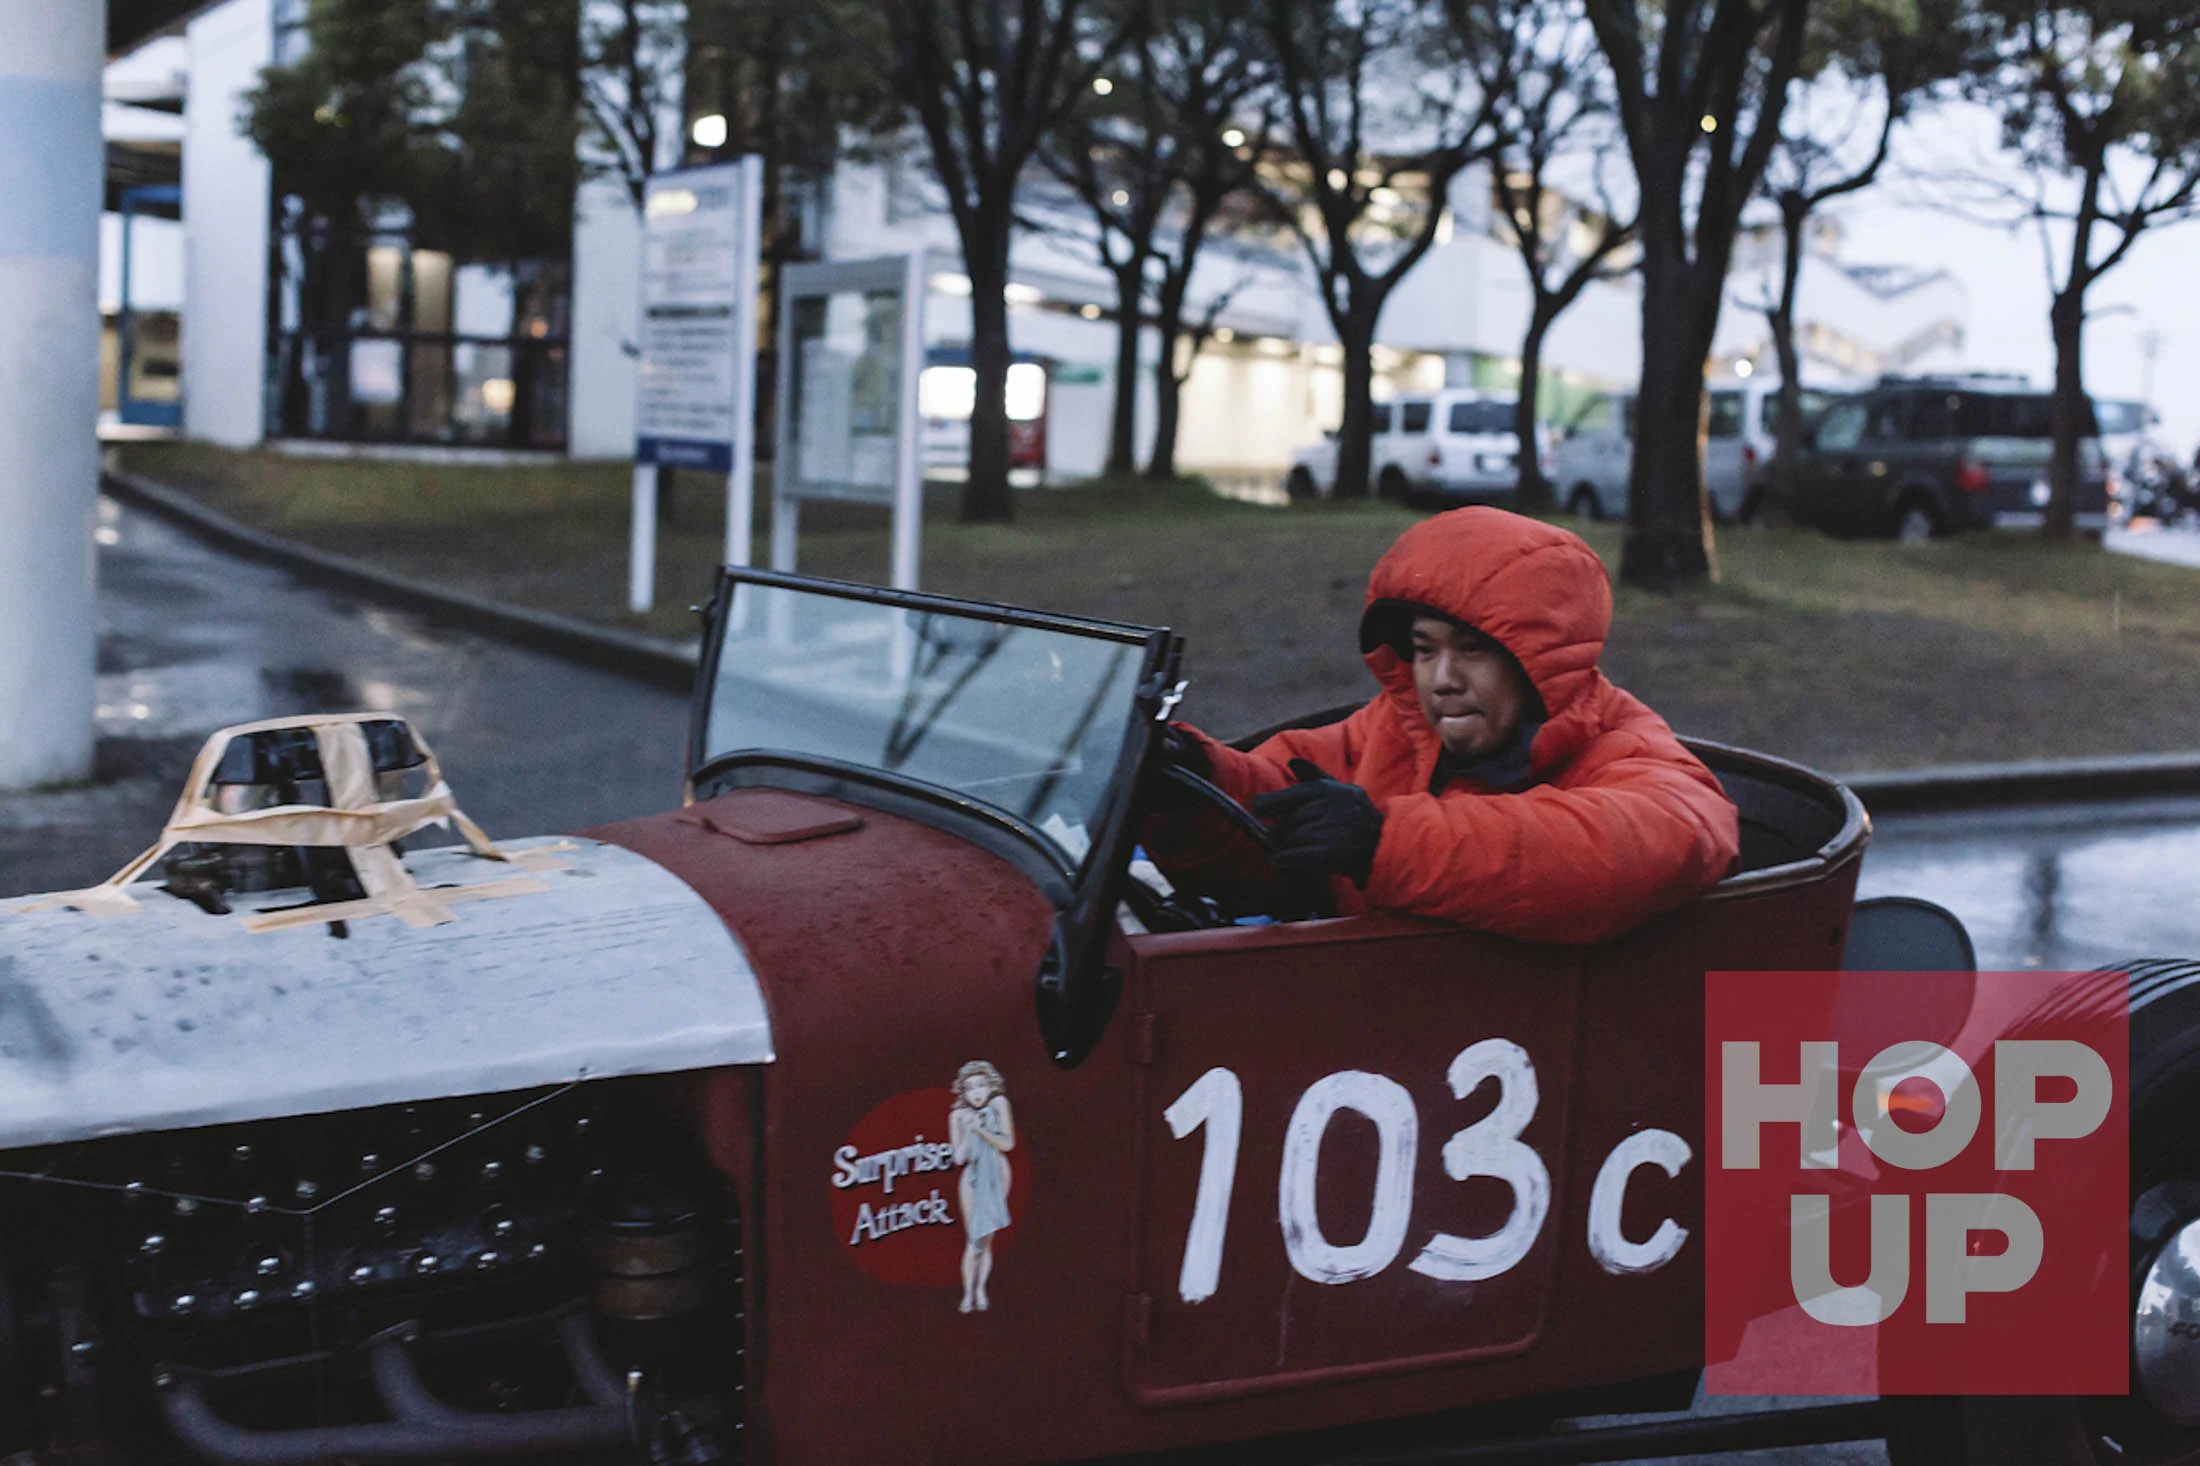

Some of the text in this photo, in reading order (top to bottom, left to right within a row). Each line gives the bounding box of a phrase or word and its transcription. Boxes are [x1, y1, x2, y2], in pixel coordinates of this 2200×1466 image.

[831, 1134, 955, 1194] Surprise
[1163, 1037, 1552, 1304] 103
[849, 1188, 956, 1246] Attack
